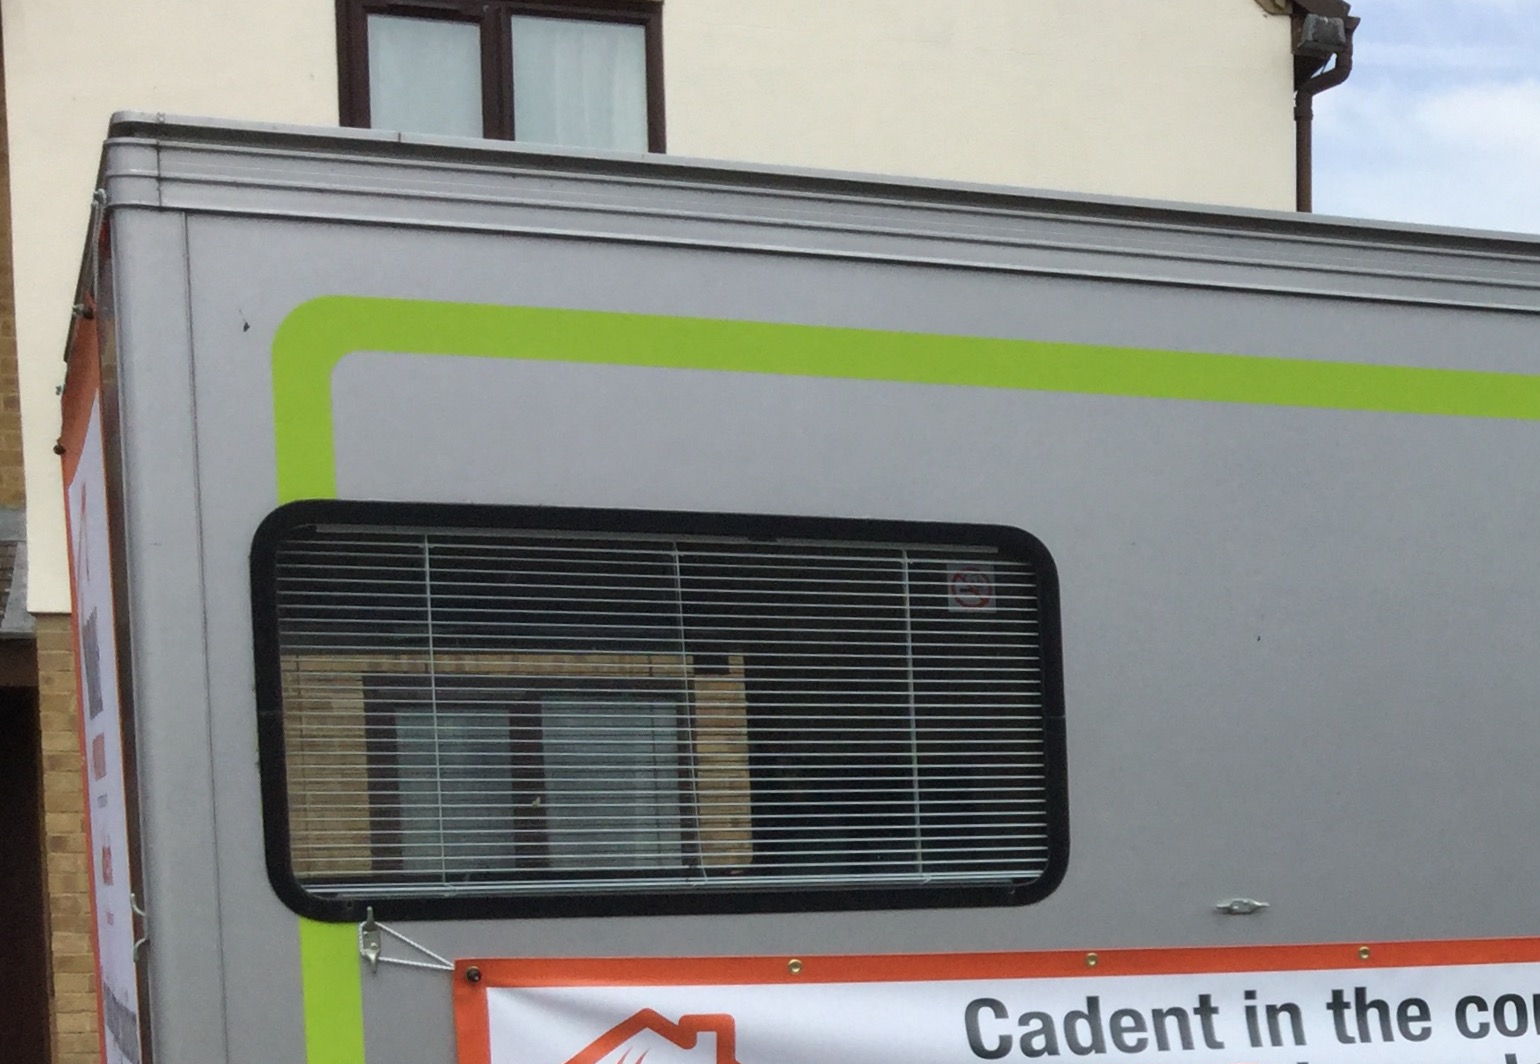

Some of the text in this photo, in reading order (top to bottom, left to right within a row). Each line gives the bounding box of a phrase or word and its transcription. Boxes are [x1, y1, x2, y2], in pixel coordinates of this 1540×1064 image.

[964, 993, 1225, 1060] Cadent
[1243, 989, 1307, 1048] in
[1326, 986, 1433, 1044] the
